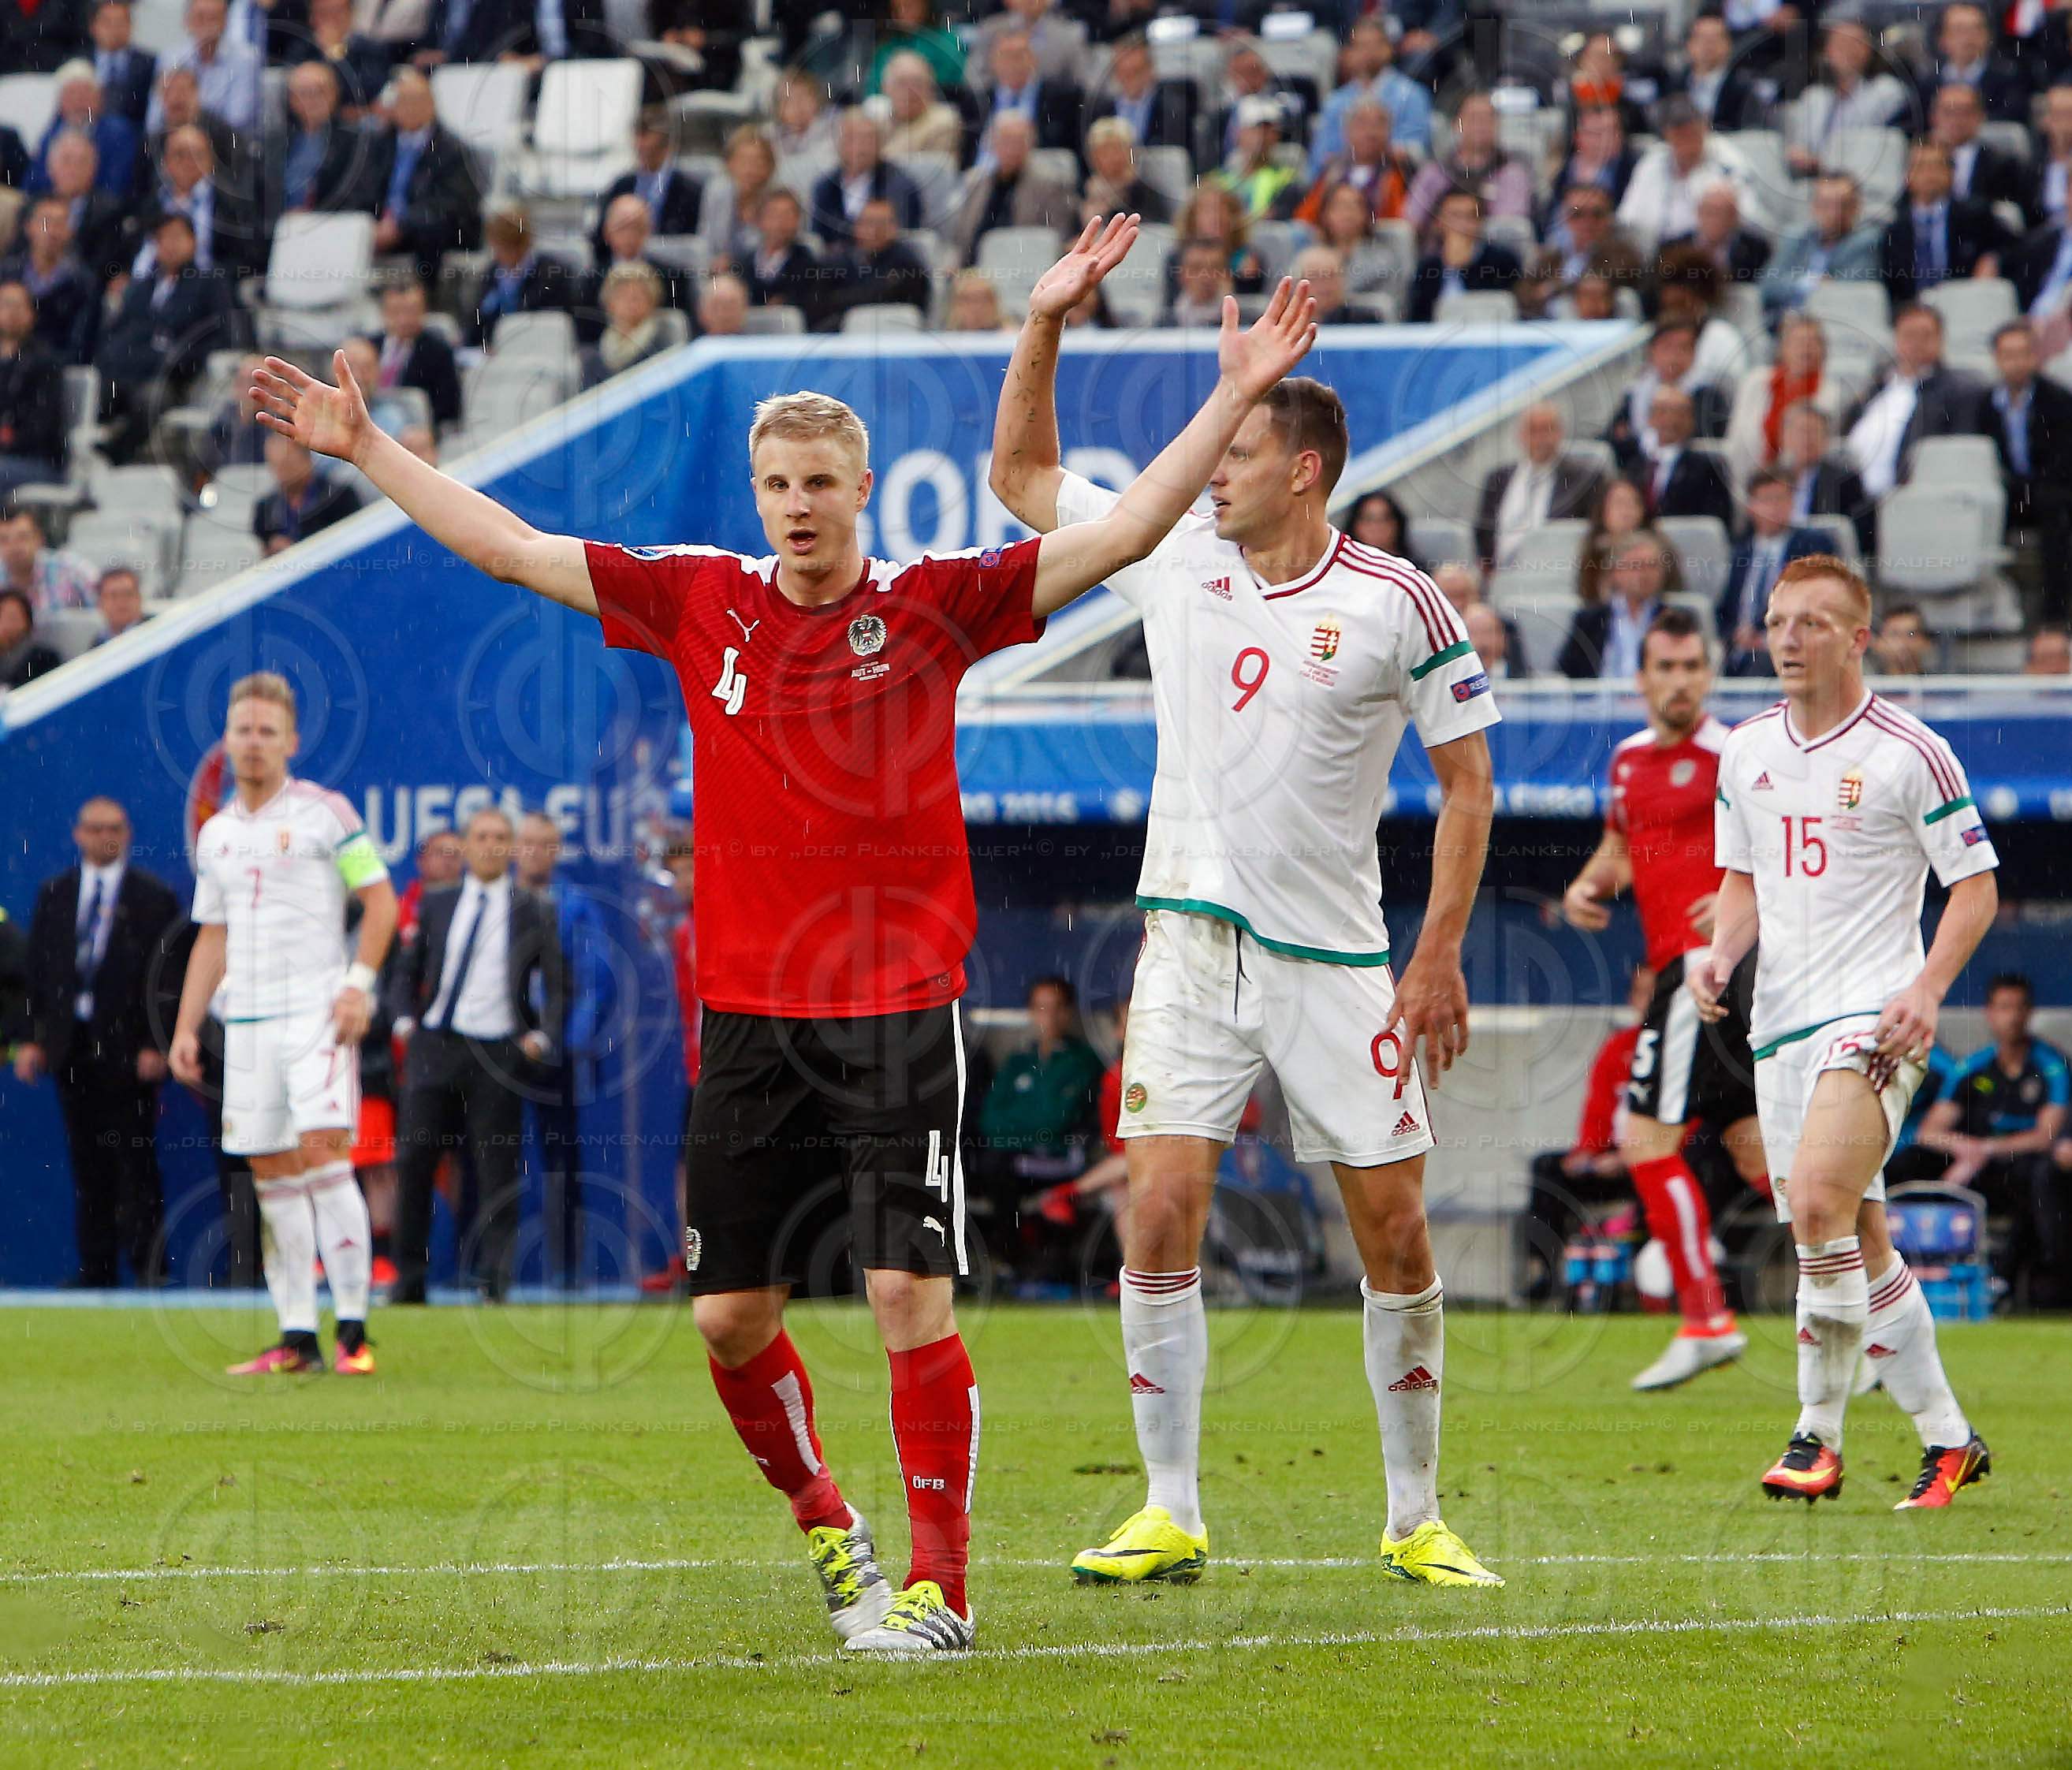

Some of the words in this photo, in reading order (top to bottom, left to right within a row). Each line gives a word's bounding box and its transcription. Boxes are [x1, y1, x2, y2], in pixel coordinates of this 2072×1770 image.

[711, 647, 748, 716] 4
[1231, 647, 1270, 712] 9
[1781, 815, 1829, 878] 15
[245, 866, 263, 908] 7
[318, 1047, 337, 1091] 7
[1370, 1032, 1403, 1100] 9
[1631, 1028, 1660, 1079] 5
[926, 1130, 949, 1202] 4
[1388, 1378, 1439, 1393] adidas
[912, 1475, 945, 1491] ÖFB
